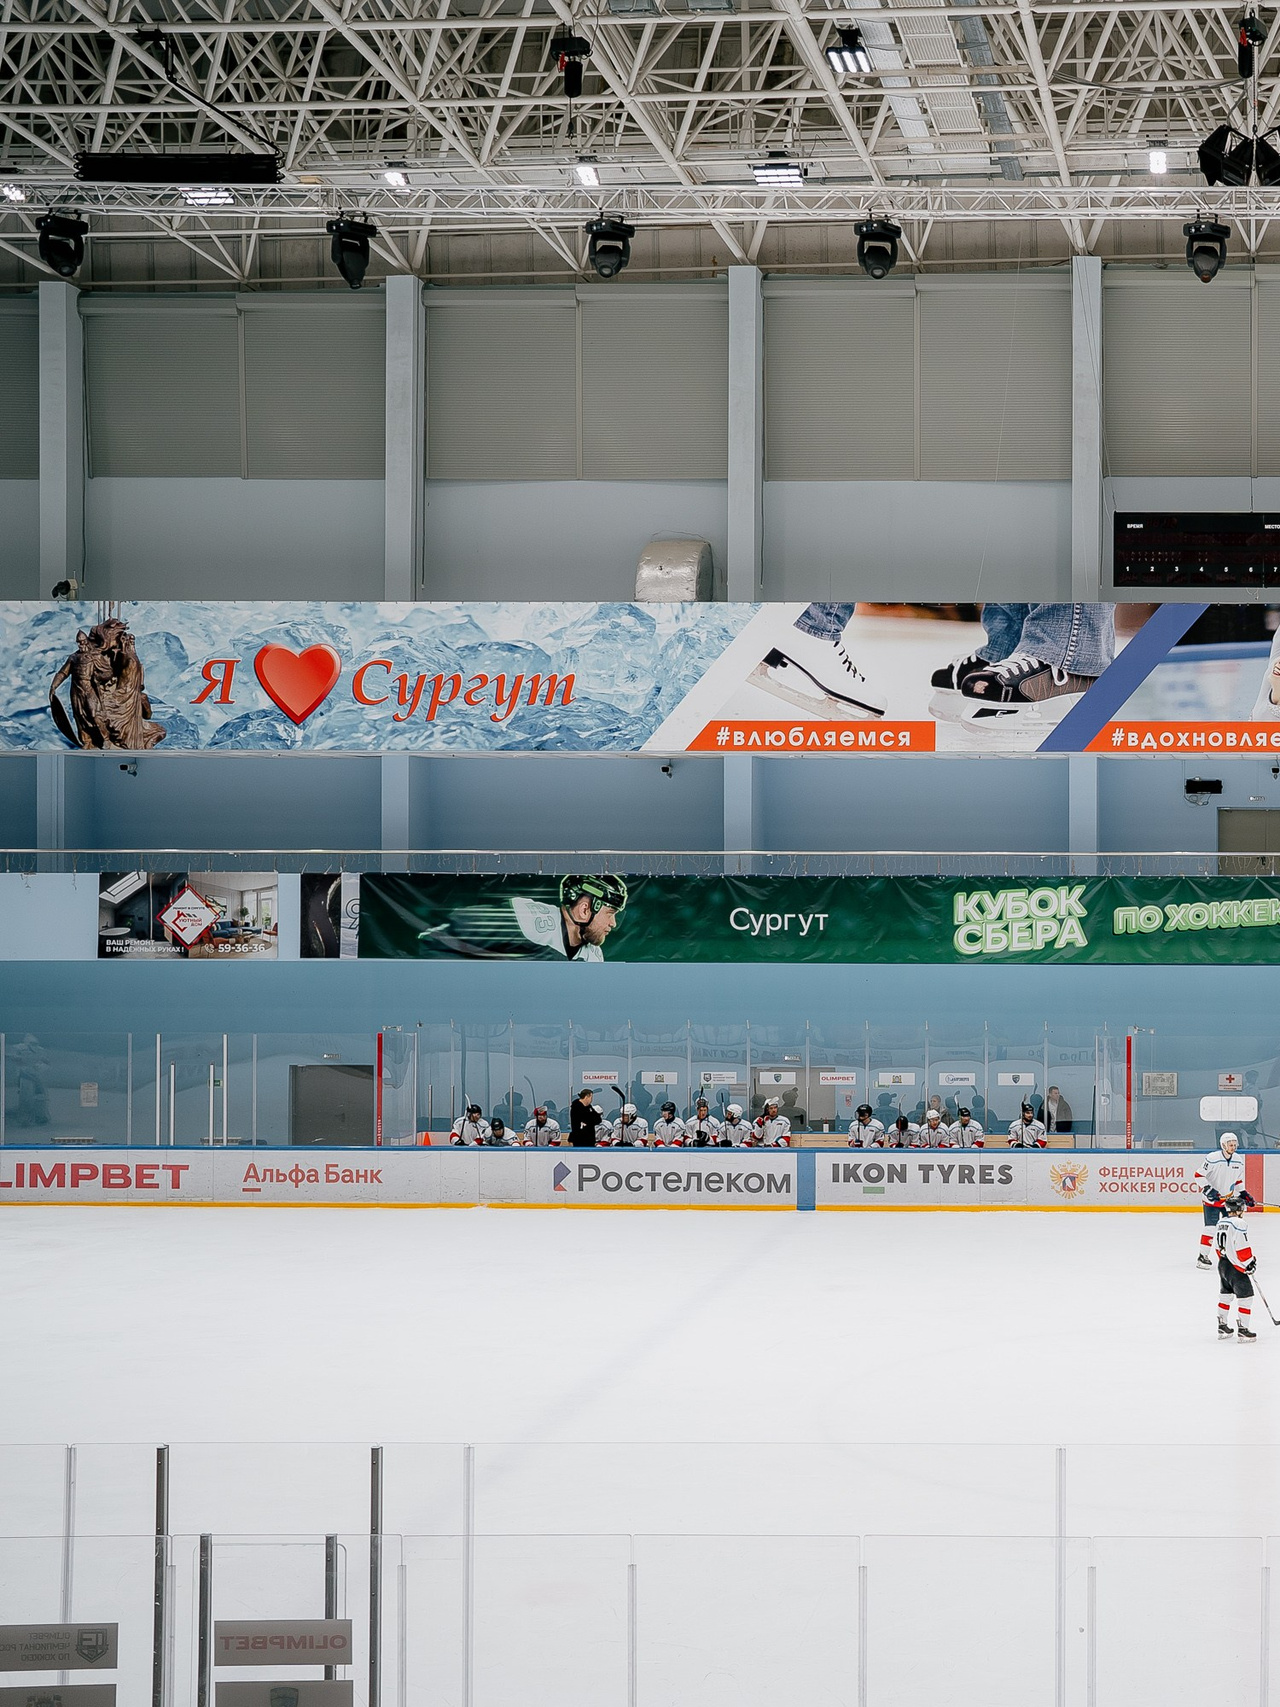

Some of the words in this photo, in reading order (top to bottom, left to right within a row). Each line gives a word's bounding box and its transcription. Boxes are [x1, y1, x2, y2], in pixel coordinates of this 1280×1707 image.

[190, 658, 241, 705] Я
[351, 659, 577, 723] Сургут
[715, 726, 912, 748] #влюбляемся
[954, 886, 1087, 925] КУБОК
[729, 907, 829, 936] Сургут
[1114, 906, 1163, 935] ПО
[218, 944, 266, 953] 59-36-36
[953, 917, 1088, 954] СБЕРА
[243, 1162, 319, 1188] Альфа
[325, 1164, 384, 1184] Банк
[578, 1163, 791, 1194] Ростелеком
[832, 1163, 907, 1184] IKON
[918, 1164, 1013, 1185] TYRES
[1098, 1166, 1184, 1180] ФЕДЕРАЦИЯ
[1099, 1182, 1156, 1193] ХОККЕЯ
